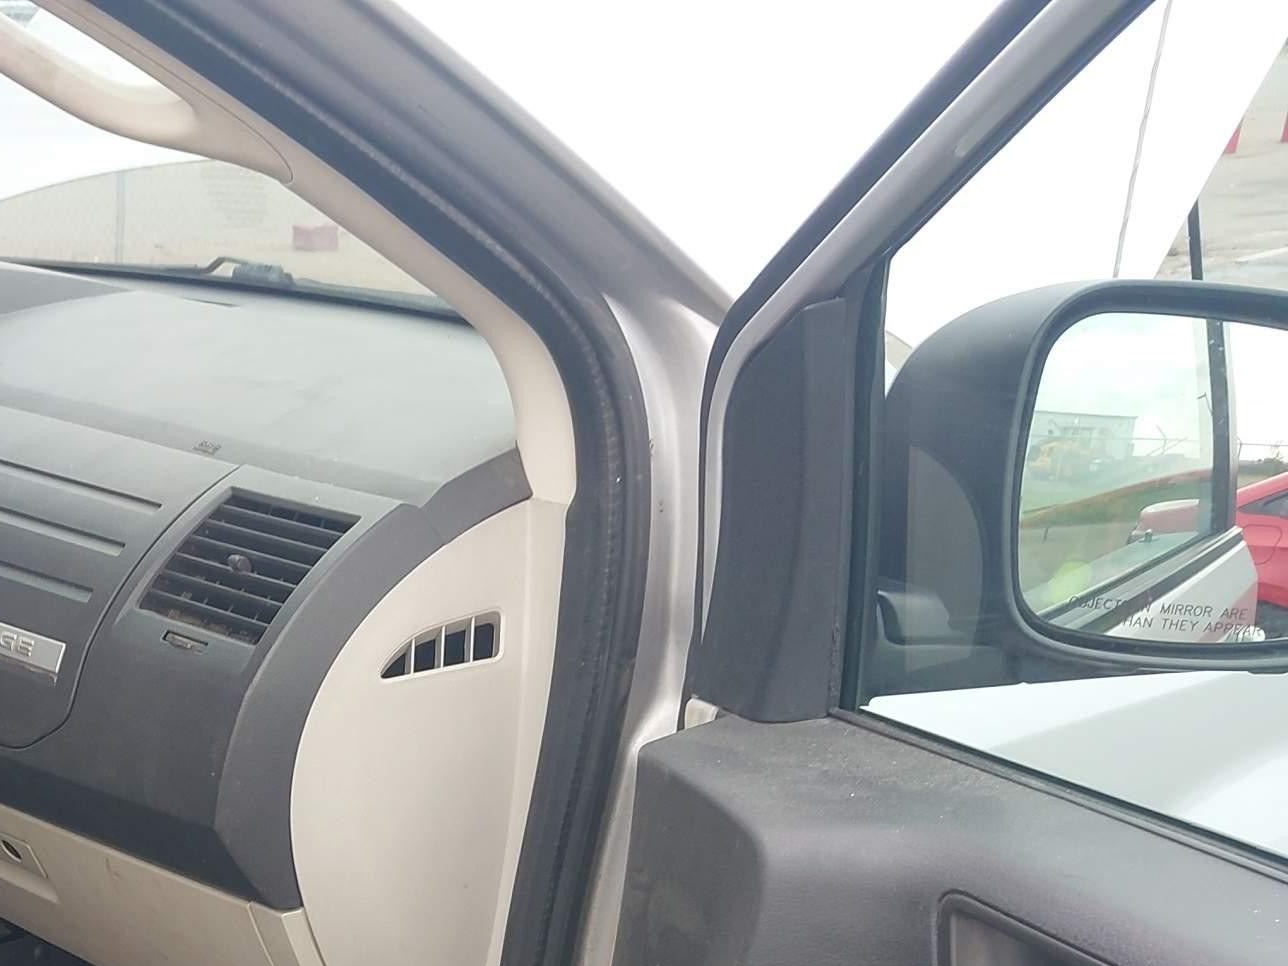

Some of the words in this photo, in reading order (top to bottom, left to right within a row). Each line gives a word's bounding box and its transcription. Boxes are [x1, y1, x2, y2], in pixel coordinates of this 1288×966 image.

[1069, 596, 1129, 611] OBJECT
[1160, 603, 1213, 617] MIRROR
[1220, 608, 1249, 620] ARE
[1119, 616, 1153, 628] HAN
[1162, 619, 1199, 632] THEY
[1203, 622, 1264, 637] APPEAR
